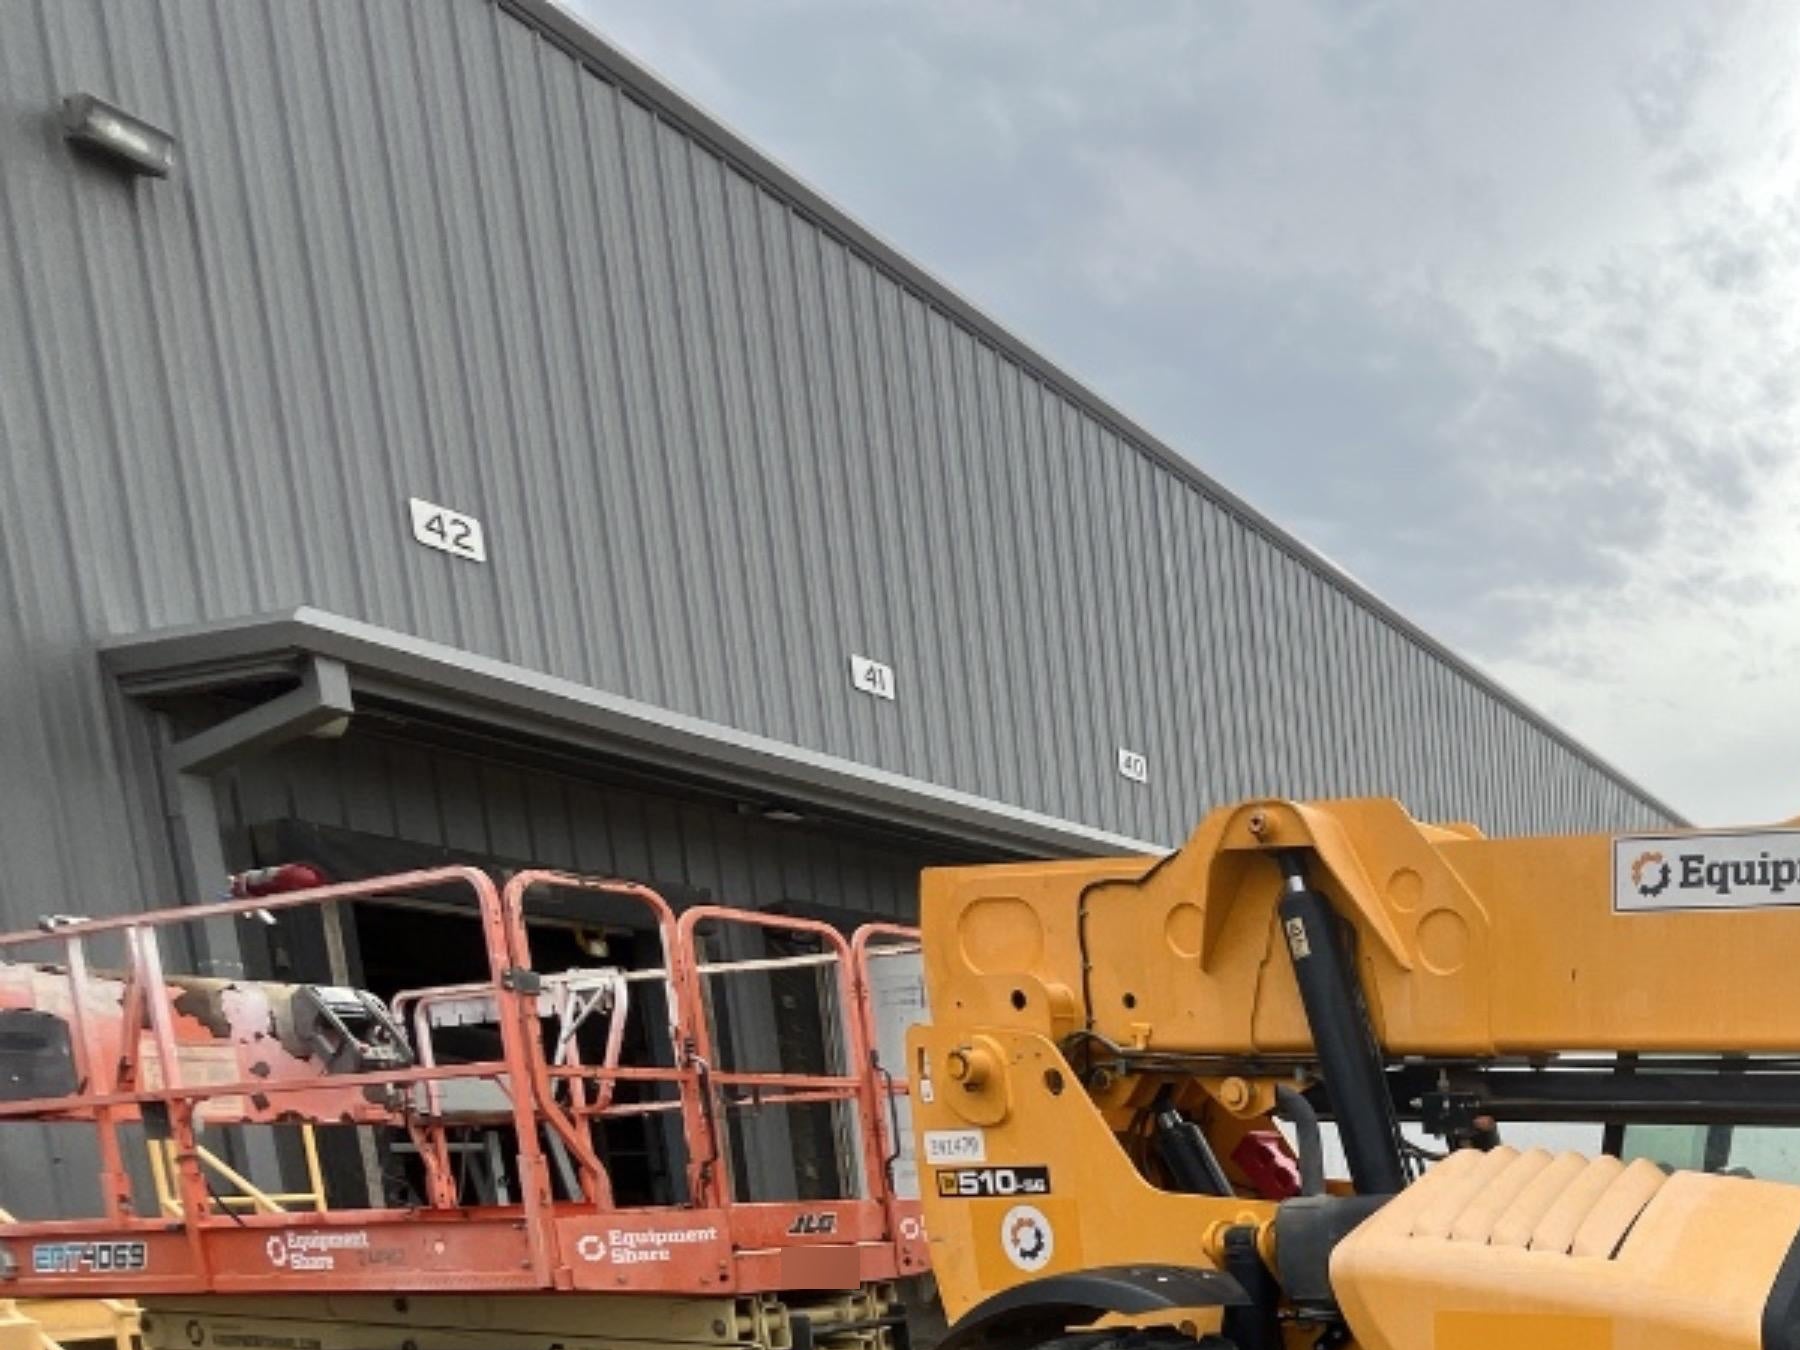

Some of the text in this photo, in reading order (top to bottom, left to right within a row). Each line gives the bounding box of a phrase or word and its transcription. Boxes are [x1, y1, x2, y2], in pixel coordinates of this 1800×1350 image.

[424, 512, 476, 551] 42
[863, 664, 887, 692] 41
[1122, 755, 1145, 777] 40
[786, 1212, 837, 1236] JLG
[286, 1230, 369, 1251] Equipment
[609, 1227, 718, 1248] Equipment
[290, 1252, 335, 1270] Share
[611, 1246, 671, 1264] Share
